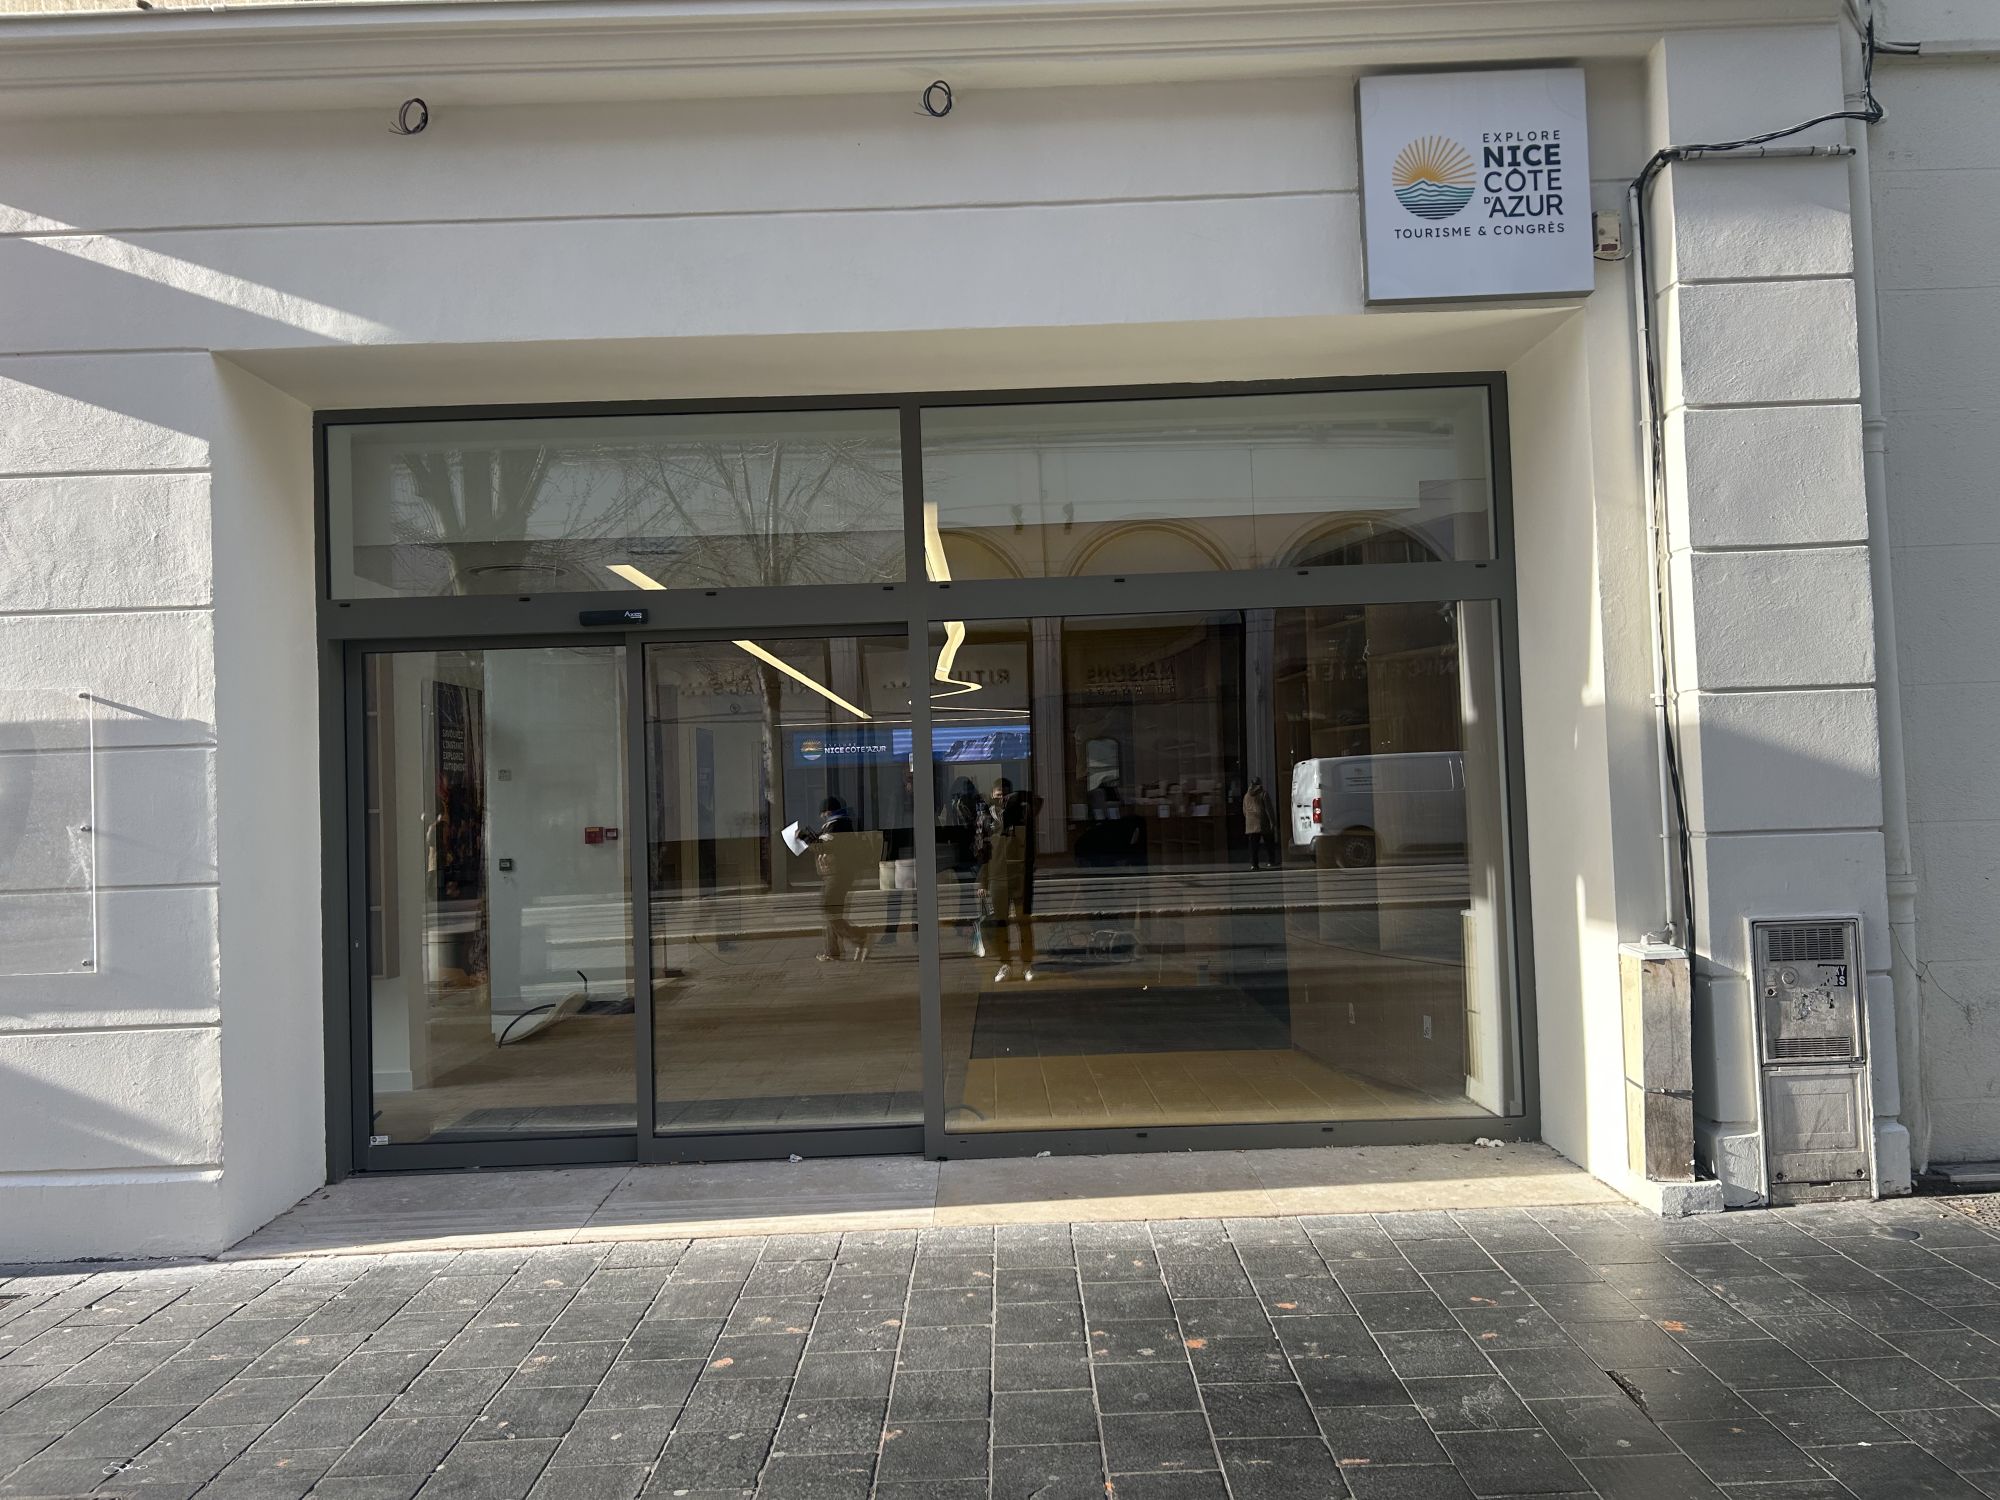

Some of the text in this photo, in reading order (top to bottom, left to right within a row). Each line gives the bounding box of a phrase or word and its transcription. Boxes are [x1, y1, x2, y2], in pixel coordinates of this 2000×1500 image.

[1483, 130, 1561, 143] EXPLORE
[1483, 143, 1562, 168] NICE
[1484, 168, 1562, 193] CÔTE
[1484, 194, 1564, 218] D'AZUR
[1395, 221, 1565, 239] TOURISME & CONGRÈS
